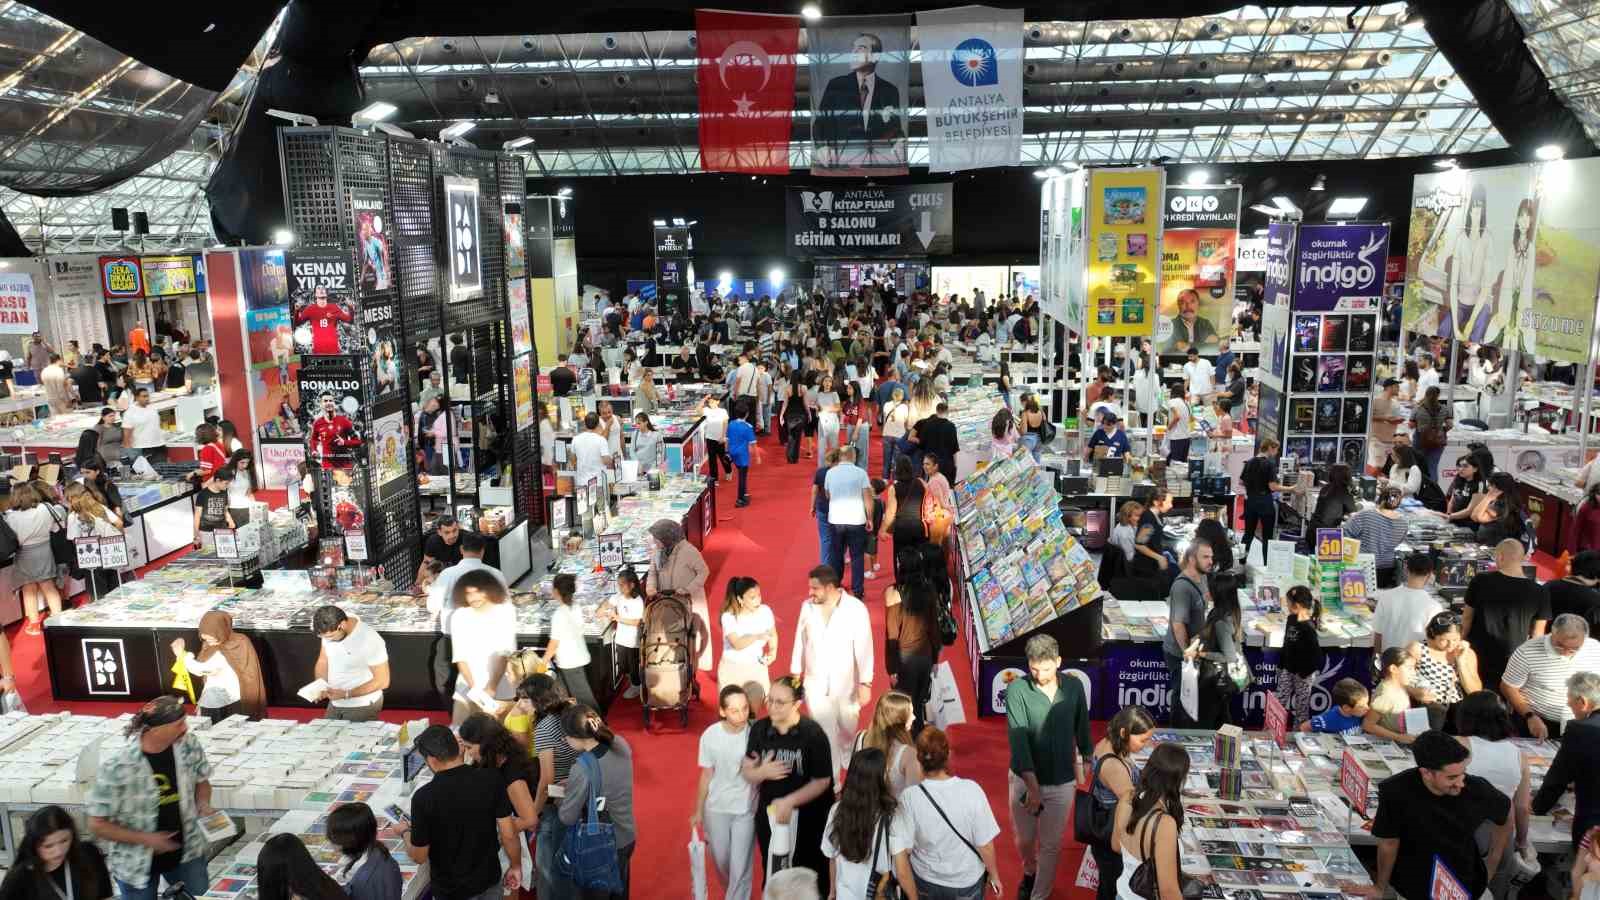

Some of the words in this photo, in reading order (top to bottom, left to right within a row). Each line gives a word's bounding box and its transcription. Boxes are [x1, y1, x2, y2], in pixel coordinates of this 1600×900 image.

[949, 93, 1004, 108] ANTALYA
[936, 108, 1018, 128] BÜYÜKŞEHİR
[845, 190, 885, 199] ANTALYA
[835, 200, 864, 210] KİTAP
[865, 200, 895, 209] FUARI
[909, 193, 944, 210] ÇIKIŞ
[819, 217, 827, 229] B
[831, 217, 877, 229] SALONU
[1170, 213, 1194, 222] KREDİ
[1195, 213, 1237, 222] YAYINLARI
[795, 231, 835, 246] EĞİTİM
[839, 233, 901, 246] YAYINLARI
[1311, 239, 1348, 248] okumak
[1302, 250, 1356, 261] özgürlüktür
[292, 262, 347, 276] KENAN
[1300, 262, 1375, 289] indigo
[297, 276, 347, 289] YILDIZ
[301, 380, 360, 391] RONALDO
[1129, 658, 1169, 668] okuma
